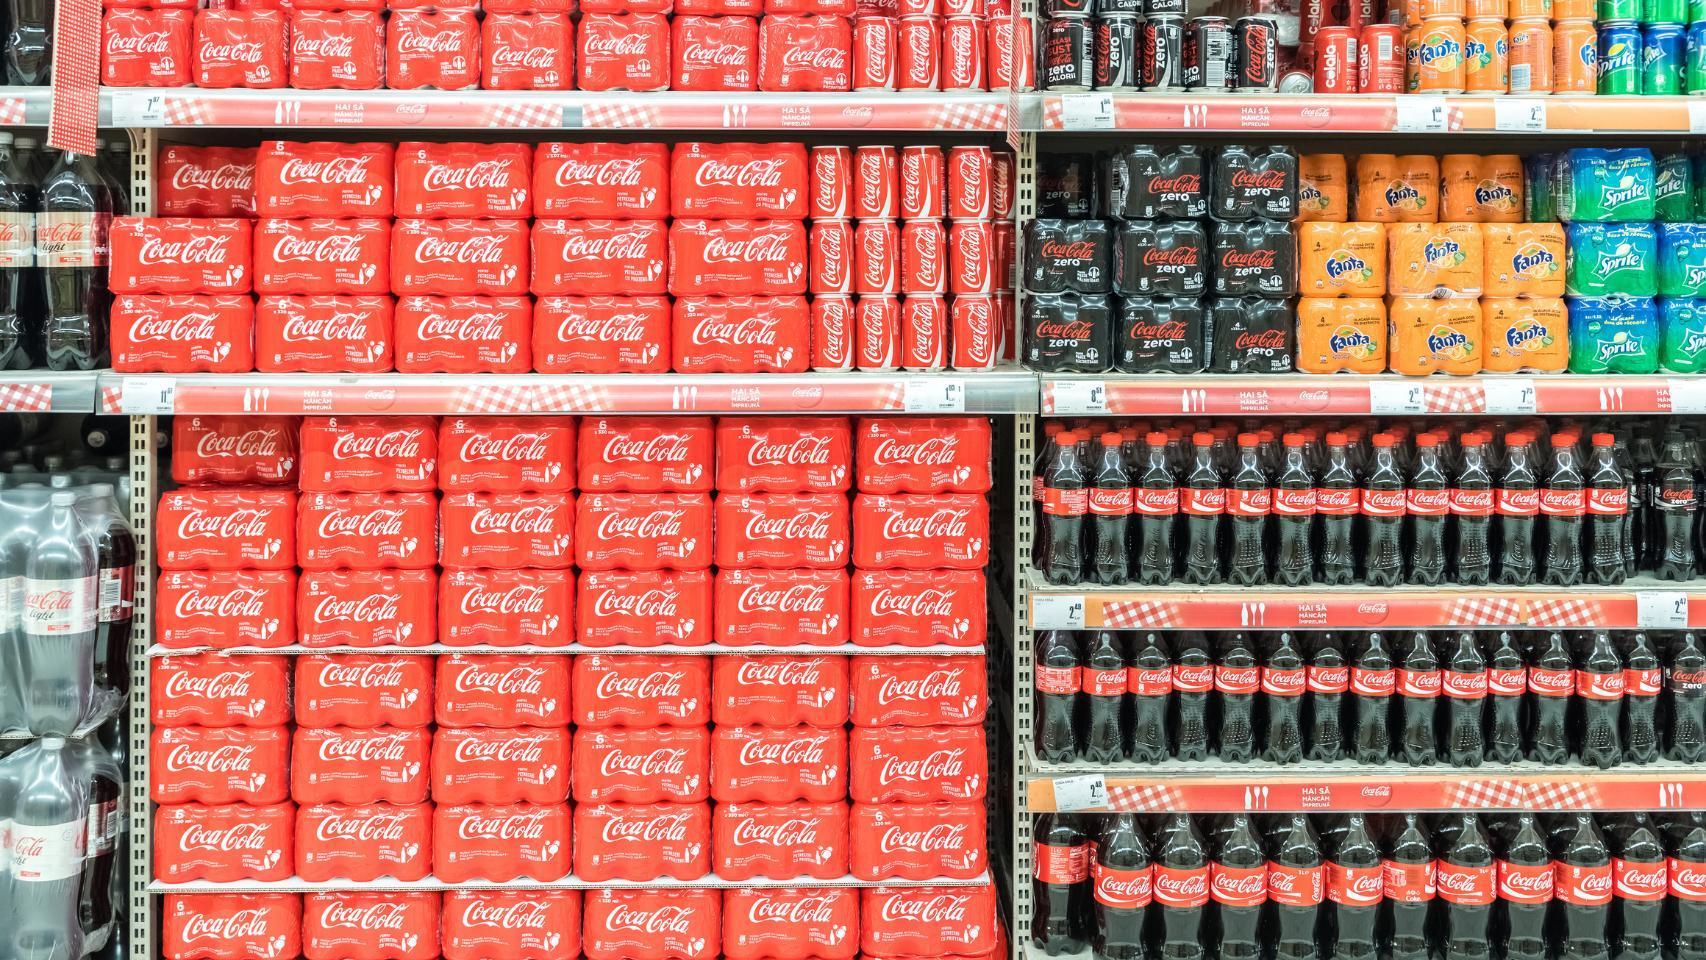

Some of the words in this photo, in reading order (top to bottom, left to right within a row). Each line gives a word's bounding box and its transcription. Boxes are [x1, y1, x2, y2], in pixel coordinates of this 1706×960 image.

[1110, 37, 1120, 68] zero
[1156, 38, 1165, 68] zero
[1420, 40, 1460, 65] Fanta
[1049, 65, 1074, 75] zero
[418, 150, 426, 159] 6
[1245, 188, 1270, 196] zero
[1386, 187, 1418, 207] Fanta
[1475, 186, 1512, 205] Fanta
[1604, 187, 1647, 207] Sprite
[1160, 193, 1190, 202] zero
[1424, 241, 1458, 262] Fanta
[1054, 258, 1080, 266] zero
[1513, 253, 1553, 273] Fanta
[1601, 254, 1639, 273] Sprite
[1157, 265, 1186, 274] zero
[1236, 267, 1261, 276] zero
[1326, 259, 1365, 278] Fanta
[124, 300, 133, 309] 6
[1506, 326, 1546, 345] Fanta
[1049, 339, 1078, 347] zero
[1144, 339, 1172, 348] zero
[1330, 332, 1370, 353] Fanta
[1428, 332, 1466, 353] Fanta
[1247, 348, 1273, 357] zero
[1601, 340, 1638, 358] Sprite
[329, 418, 337, 428] 6
[598, 420, 607, 430] 6
[174, 496, 183, 506] 6
[865, 576, 873, 586] 6
[873, 744, 881, 755] 6
[874, 811, 883, 822] 6
[176, 902, 184, 911] 6
